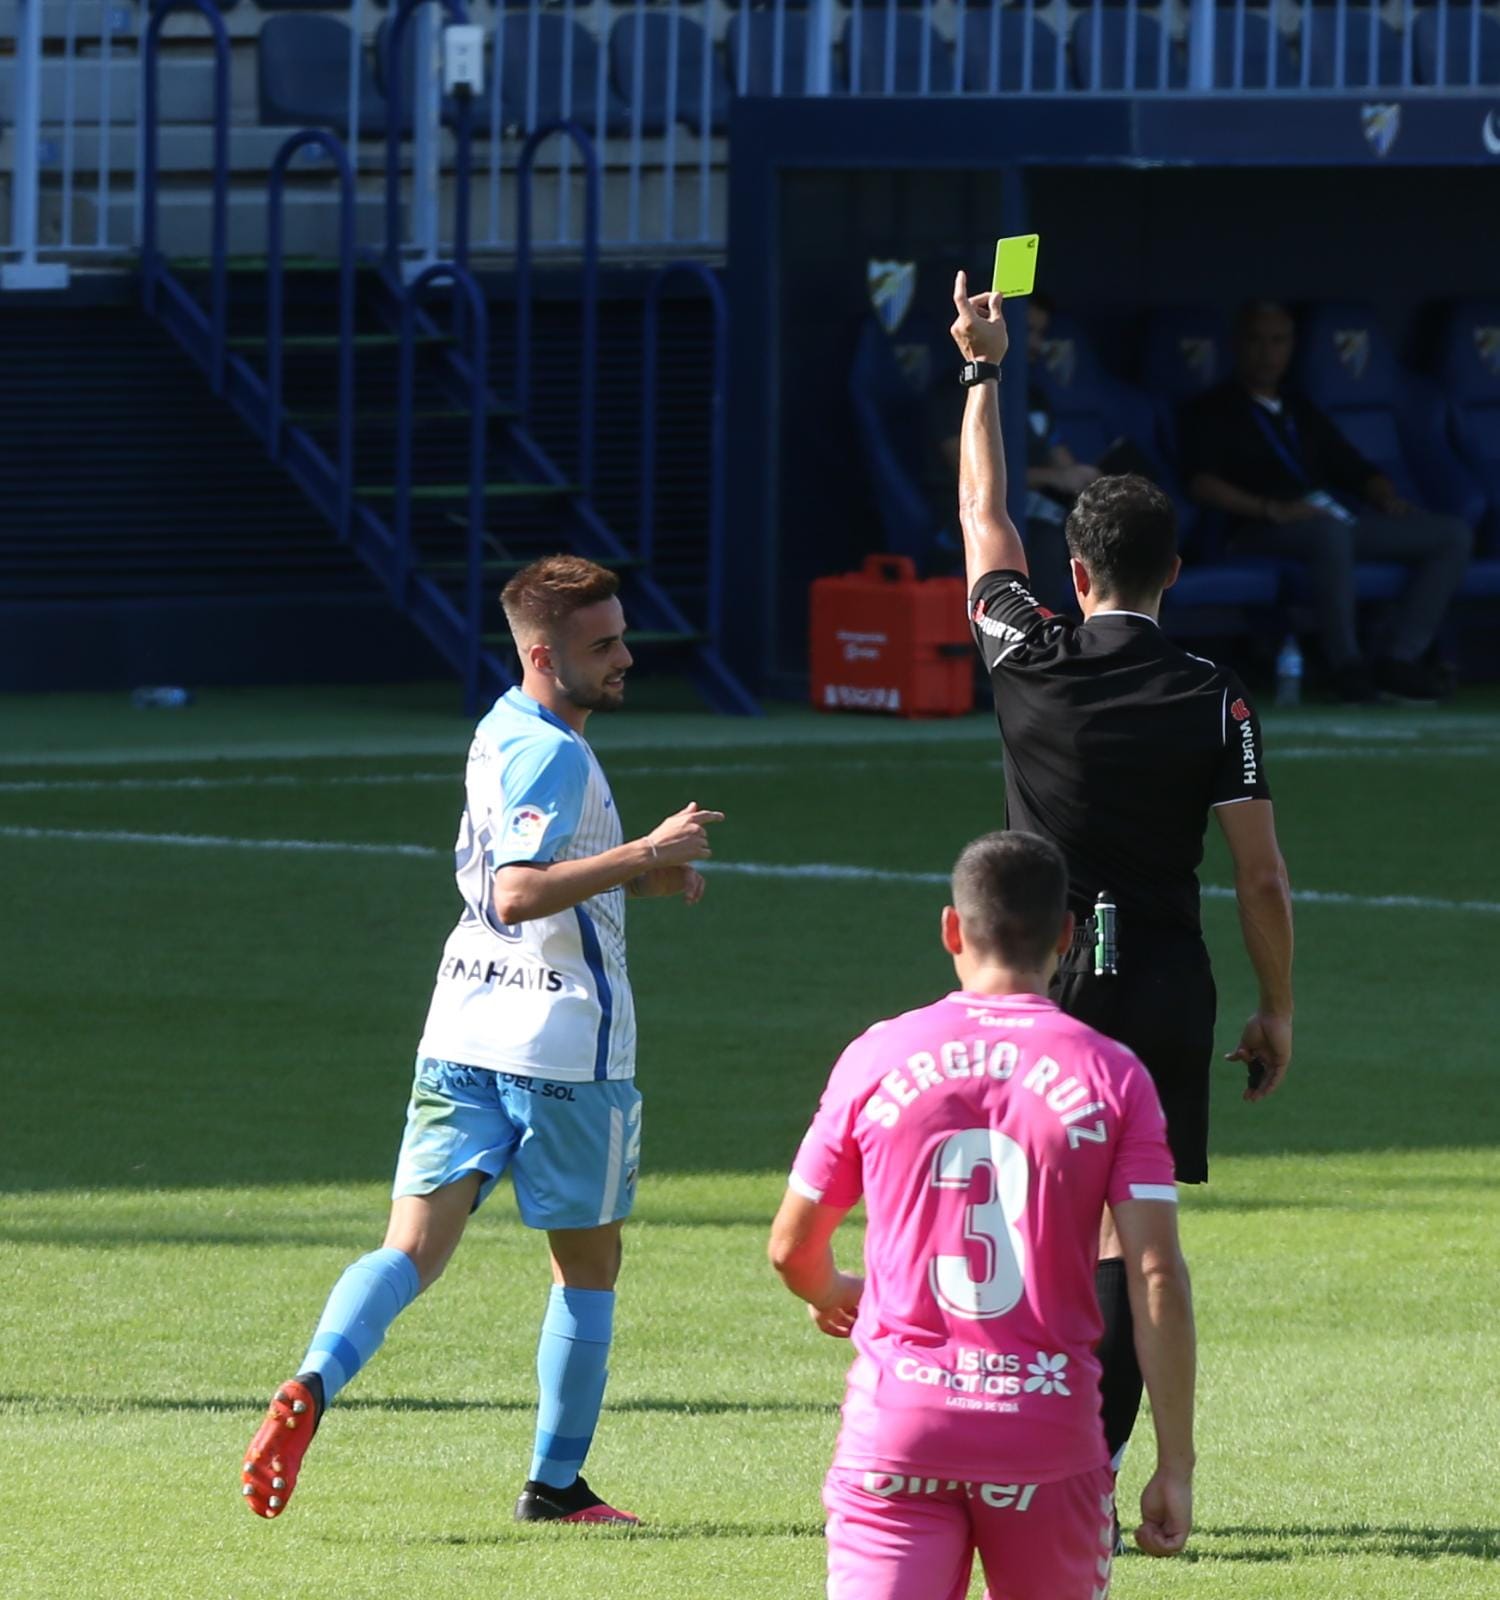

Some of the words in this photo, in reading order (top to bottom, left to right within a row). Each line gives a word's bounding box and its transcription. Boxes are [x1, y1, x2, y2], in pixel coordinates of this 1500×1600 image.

[542, 1083, 576, 1102] SOL
[864, 1039, 1019, 1128] SERGIO
[928, 1128, 1029, 1320] 3
[895, 1357, 1021, 1396] Canarias
[957, 1347, 1020, 1374] Islas
